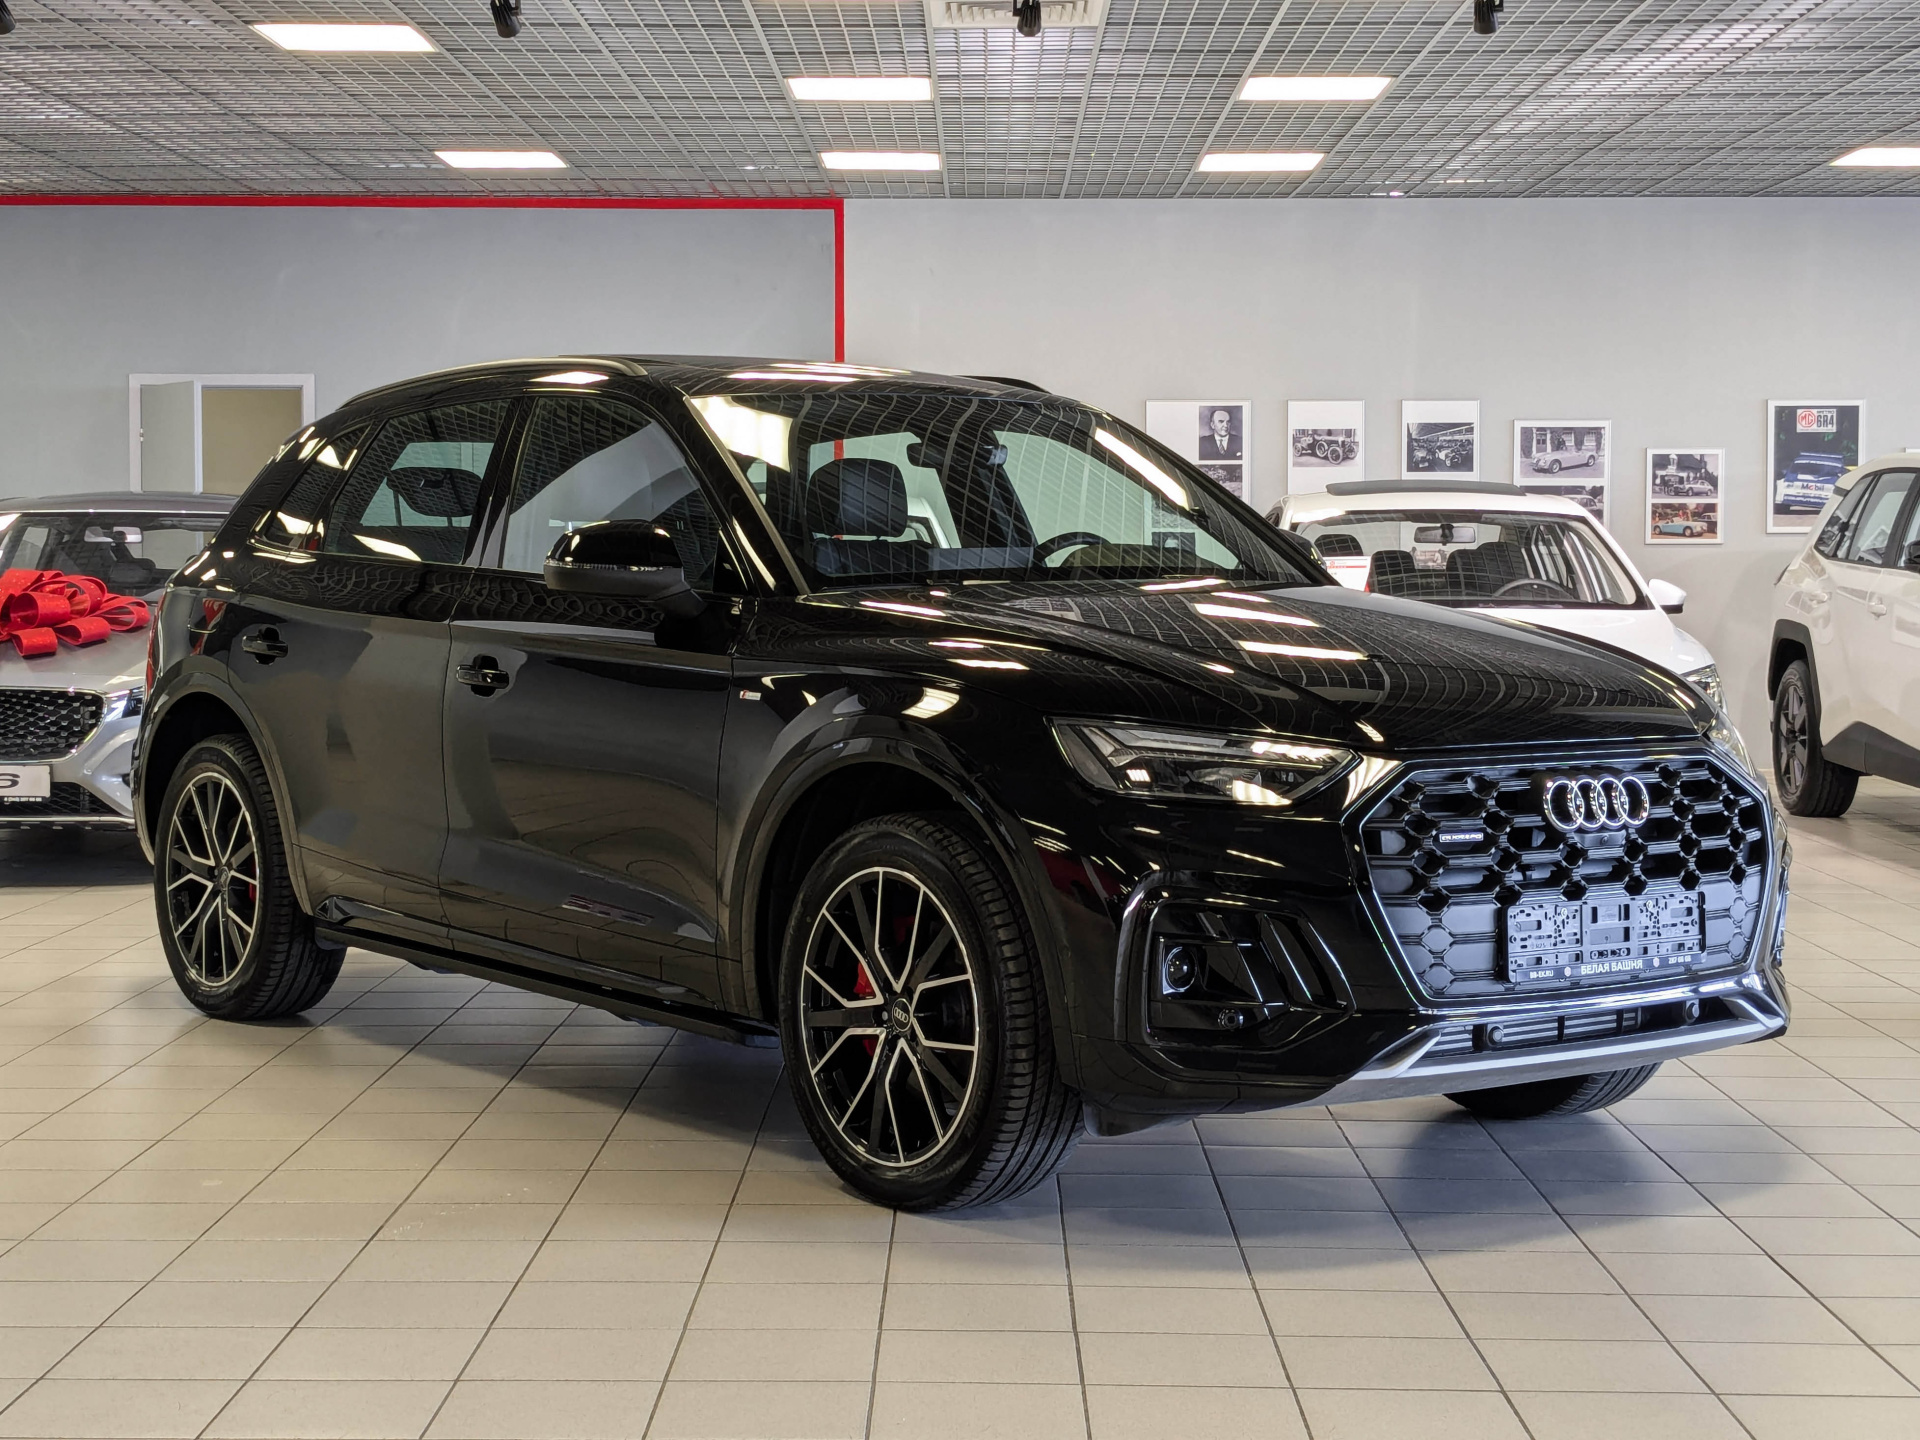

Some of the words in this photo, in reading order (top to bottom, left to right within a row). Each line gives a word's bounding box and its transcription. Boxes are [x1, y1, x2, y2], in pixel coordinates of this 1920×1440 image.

[1800, 412, 1815, 426] MG
[1816, 414, 1834, 428] 6R4
[1801, 483, 1825, 491] Mobil
[1581, 963, 1610, 975] БЕЛАЯ
[1611, 959, 1643, 972] БАШНЯ
